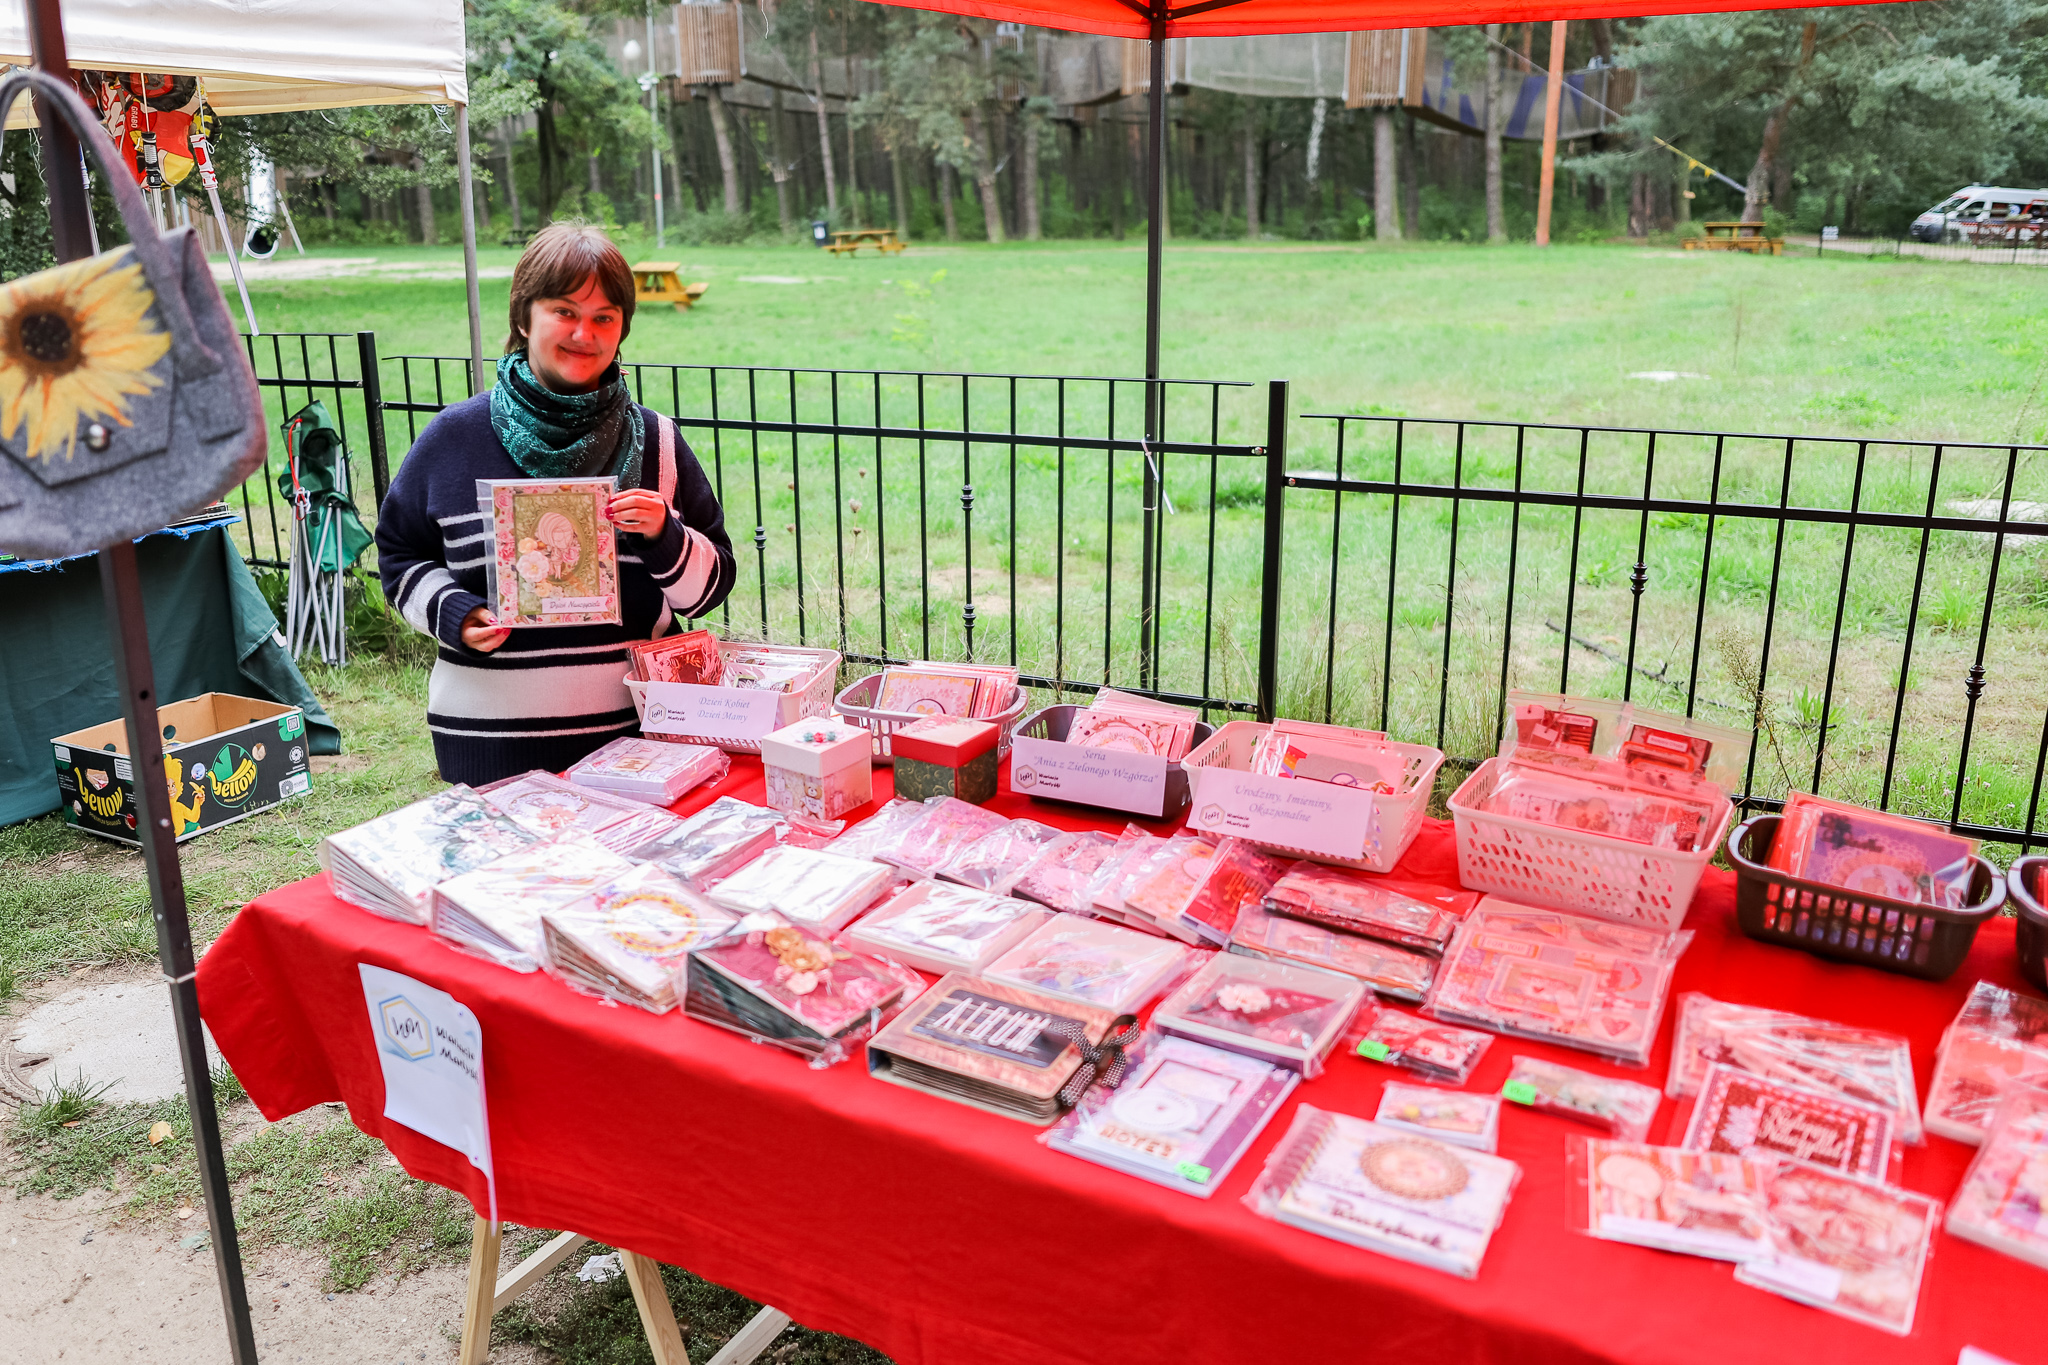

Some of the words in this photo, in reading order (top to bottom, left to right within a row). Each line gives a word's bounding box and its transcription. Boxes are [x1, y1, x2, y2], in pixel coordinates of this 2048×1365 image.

[130, 105, 138, 129] GRABO
[698, 697, 723, 707] Dzień
[724, 698, 750, 709] Kobiet
[697, 710, 721, 719] Dzień
[721, 711, 749, 724] Mamy
[1083, 749, 1106, 761] Seria
[1033, 756, 1057, 768] "Ania
[1059, 761, 1065, 769] z
[1067, 761, 1110, 778] Zielonego
[1112, 768, 1159, 783] Wzgórza"
[1248, 802, 1312, 822] Okazjonalne
[1099, 1124, 1173, 1158] NOTES
